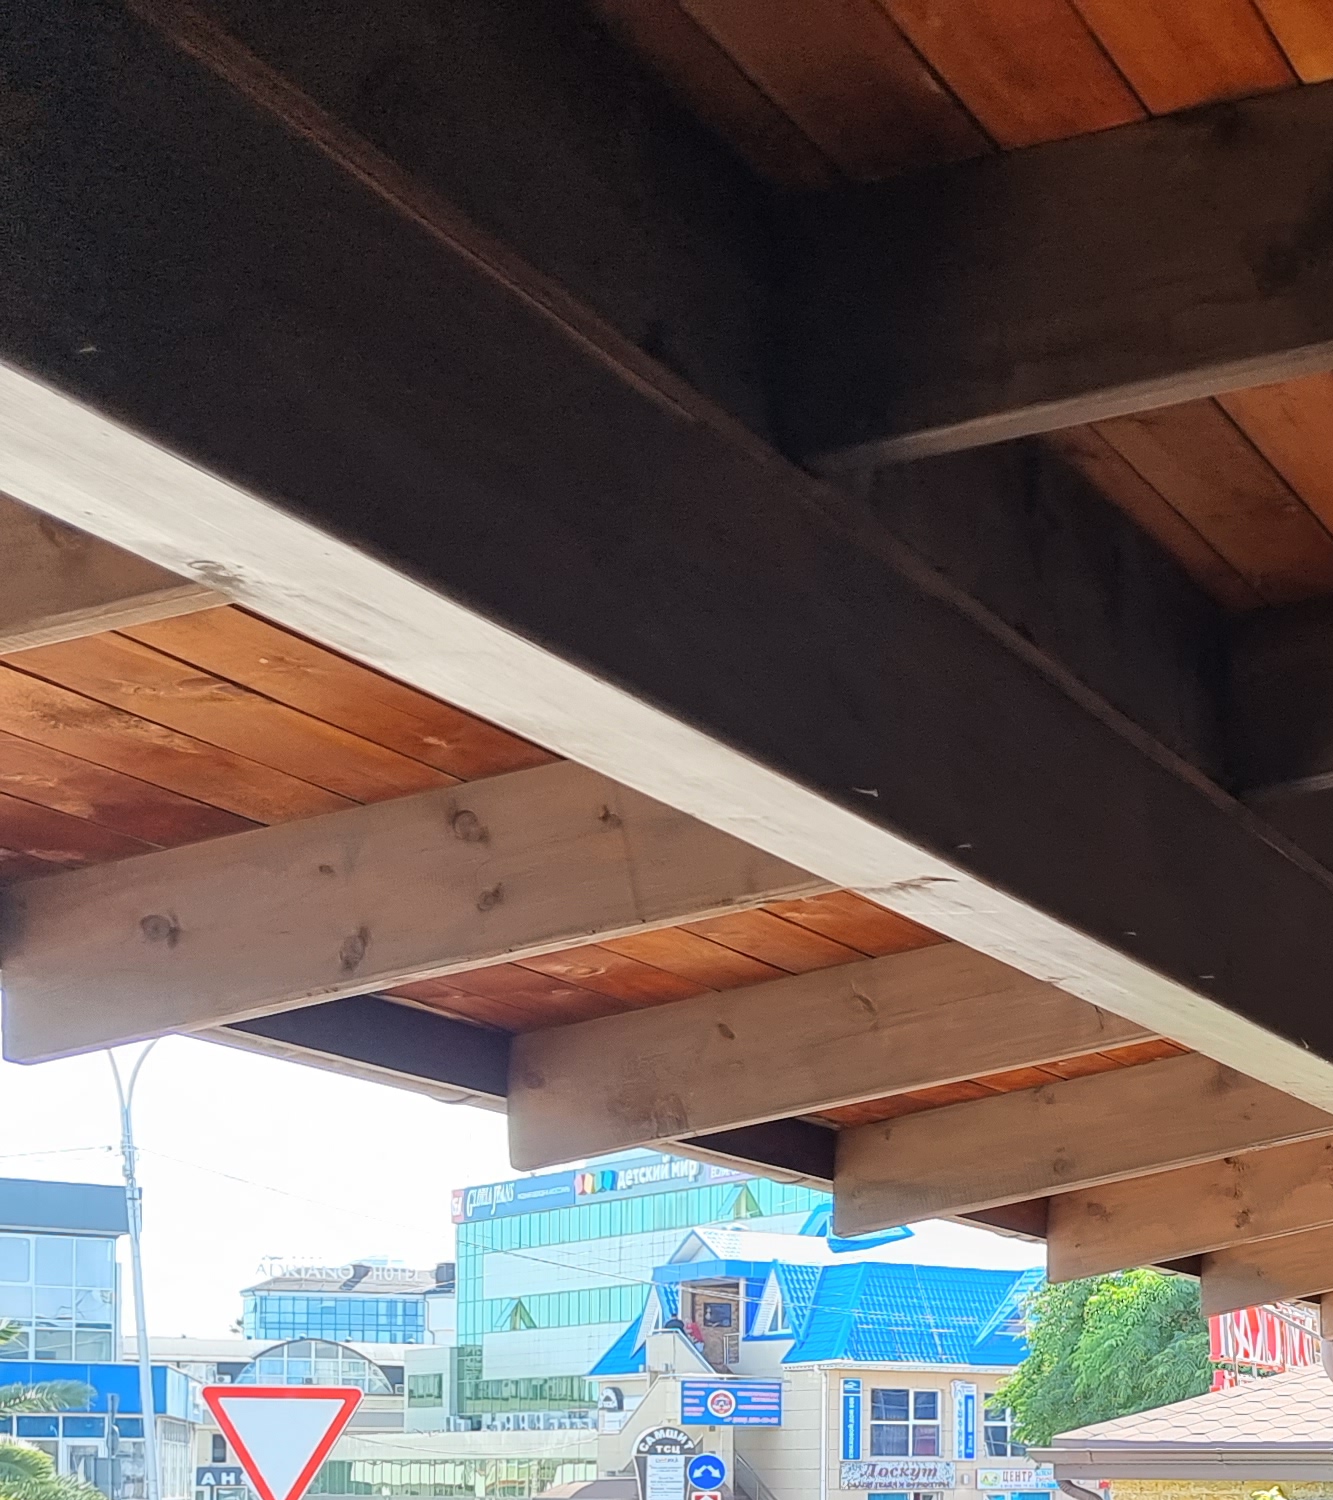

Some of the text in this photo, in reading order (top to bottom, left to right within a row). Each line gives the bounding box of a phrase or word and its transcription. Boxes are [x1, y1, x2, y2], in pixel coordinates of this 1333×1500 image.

[617, 1156, 669, 1190] детский
[671, 1159, 699, 1182] мир
[255, 1263, 420, 1282] ADRIANO HOTEL
[639, 1428, 694, 1452] САМШИТ
[655, 1445, 681, 1454] ТСЦ
[860, 1463, 938, 1481] Лоскут
[1002, 1470, 1033, 1483] ЦЕНТР
